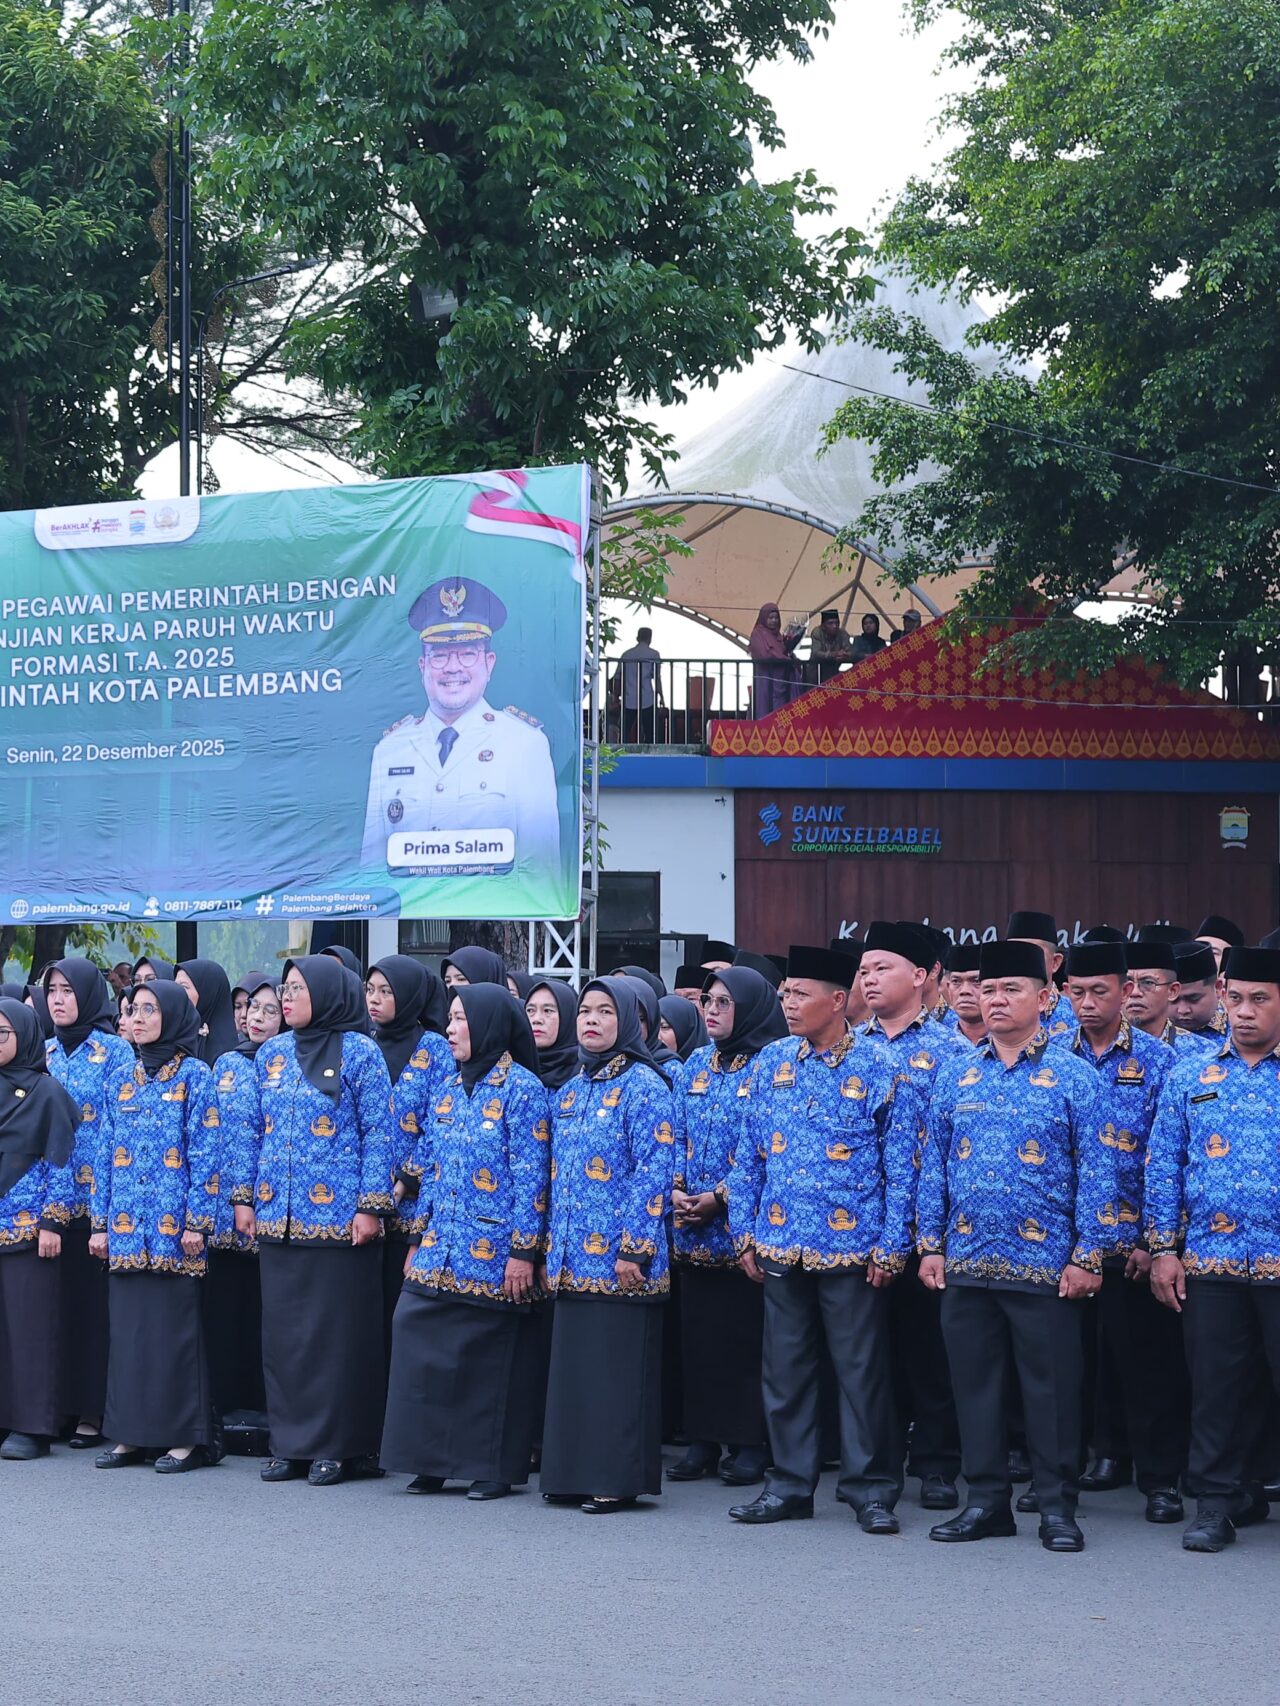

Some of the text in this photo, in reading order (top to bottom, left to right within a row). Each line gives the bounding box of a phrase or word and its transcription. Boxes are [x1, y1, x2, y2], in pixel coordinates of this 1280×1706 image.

[2, 593, 113, 619] PEGAWAI
[121, 583, 279, 612] PEMERINTAH
[288, 574, 396, 601] DENGAN
[71, 622, 147, 645] KERJA
[154, 616, 235, 641] PARUH
[243, 610, 335, 634] WAKTU
[11, 647, 235, 678] FORMASI T.A. 2025
[88, 678, 160, 704] KOTA
[167, 668, 342, 700] PALEMBANG
[6, 739, 225, 764] Senin, 22 Desember 2025
[791, 805, 846, 823] BANK
[792, 826, 942, 844] SUMSELBABEL
[404, 839, 504, 855] Prima Salam
[791, 843, 942, 854] CORPORATE SOCIAL RESPONSIBILITY
[443, 866, 457, 874] Kota
[458, 865, 495, 874] Palembang
[164, 899, 243, 911] 0811-7887-112
[282, 893, 371, 903] PalembangBerdaya
[32, 901, 131, 916] palembang.go.id
[281, 903, 378, 914] Palembang Sejahtera
